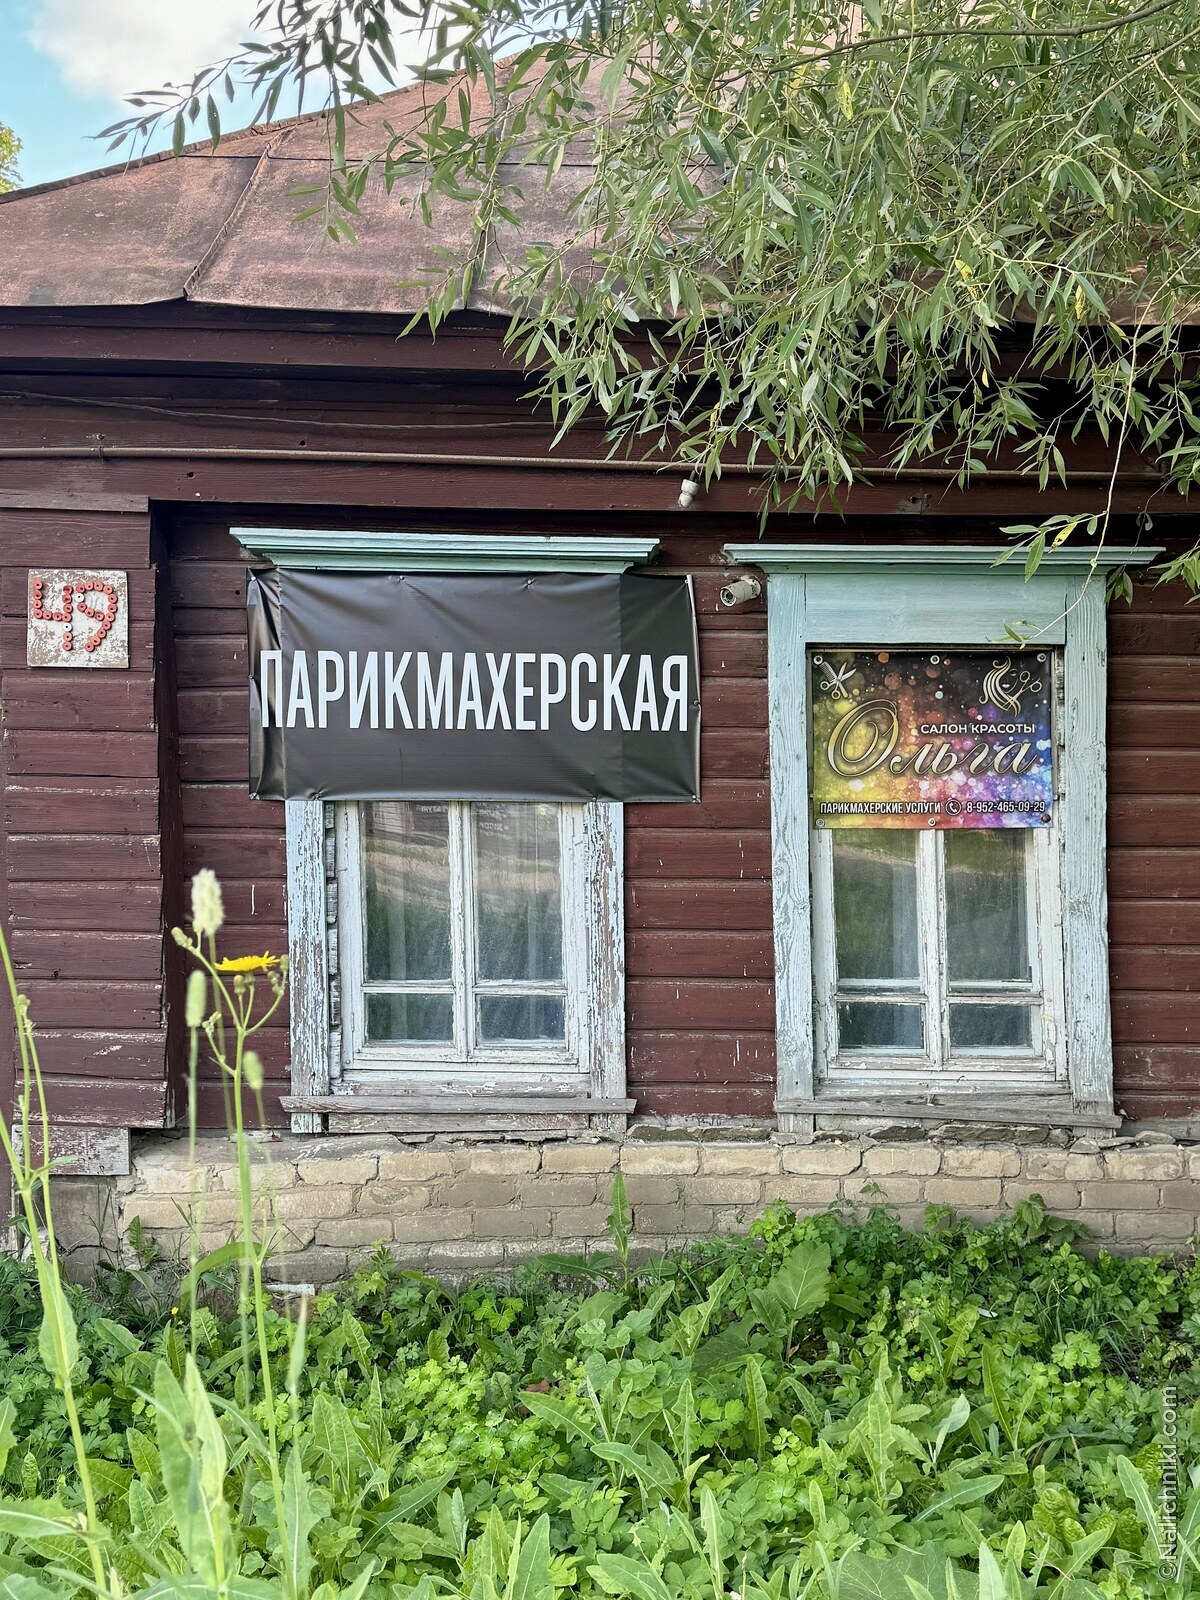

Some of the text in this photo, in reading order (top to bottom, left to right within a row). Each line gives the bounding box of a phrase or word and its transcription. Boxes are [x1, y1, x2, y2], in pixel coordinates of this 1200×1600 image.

[32, 580, 118, 653] 49
[260, 650, 689, 732] ПАРИКМАХЕРСКАЯ
[827, 699, 1037, 777] Ольга
[920, 723, 1036, 735] САЛОН КРАСОТЫ
[820, 801, 941, 814] ПАРИКМАХЕРСКИЕ УСЛУГИ
[966, 800, 1046, 813] 8-952-465-09-29
